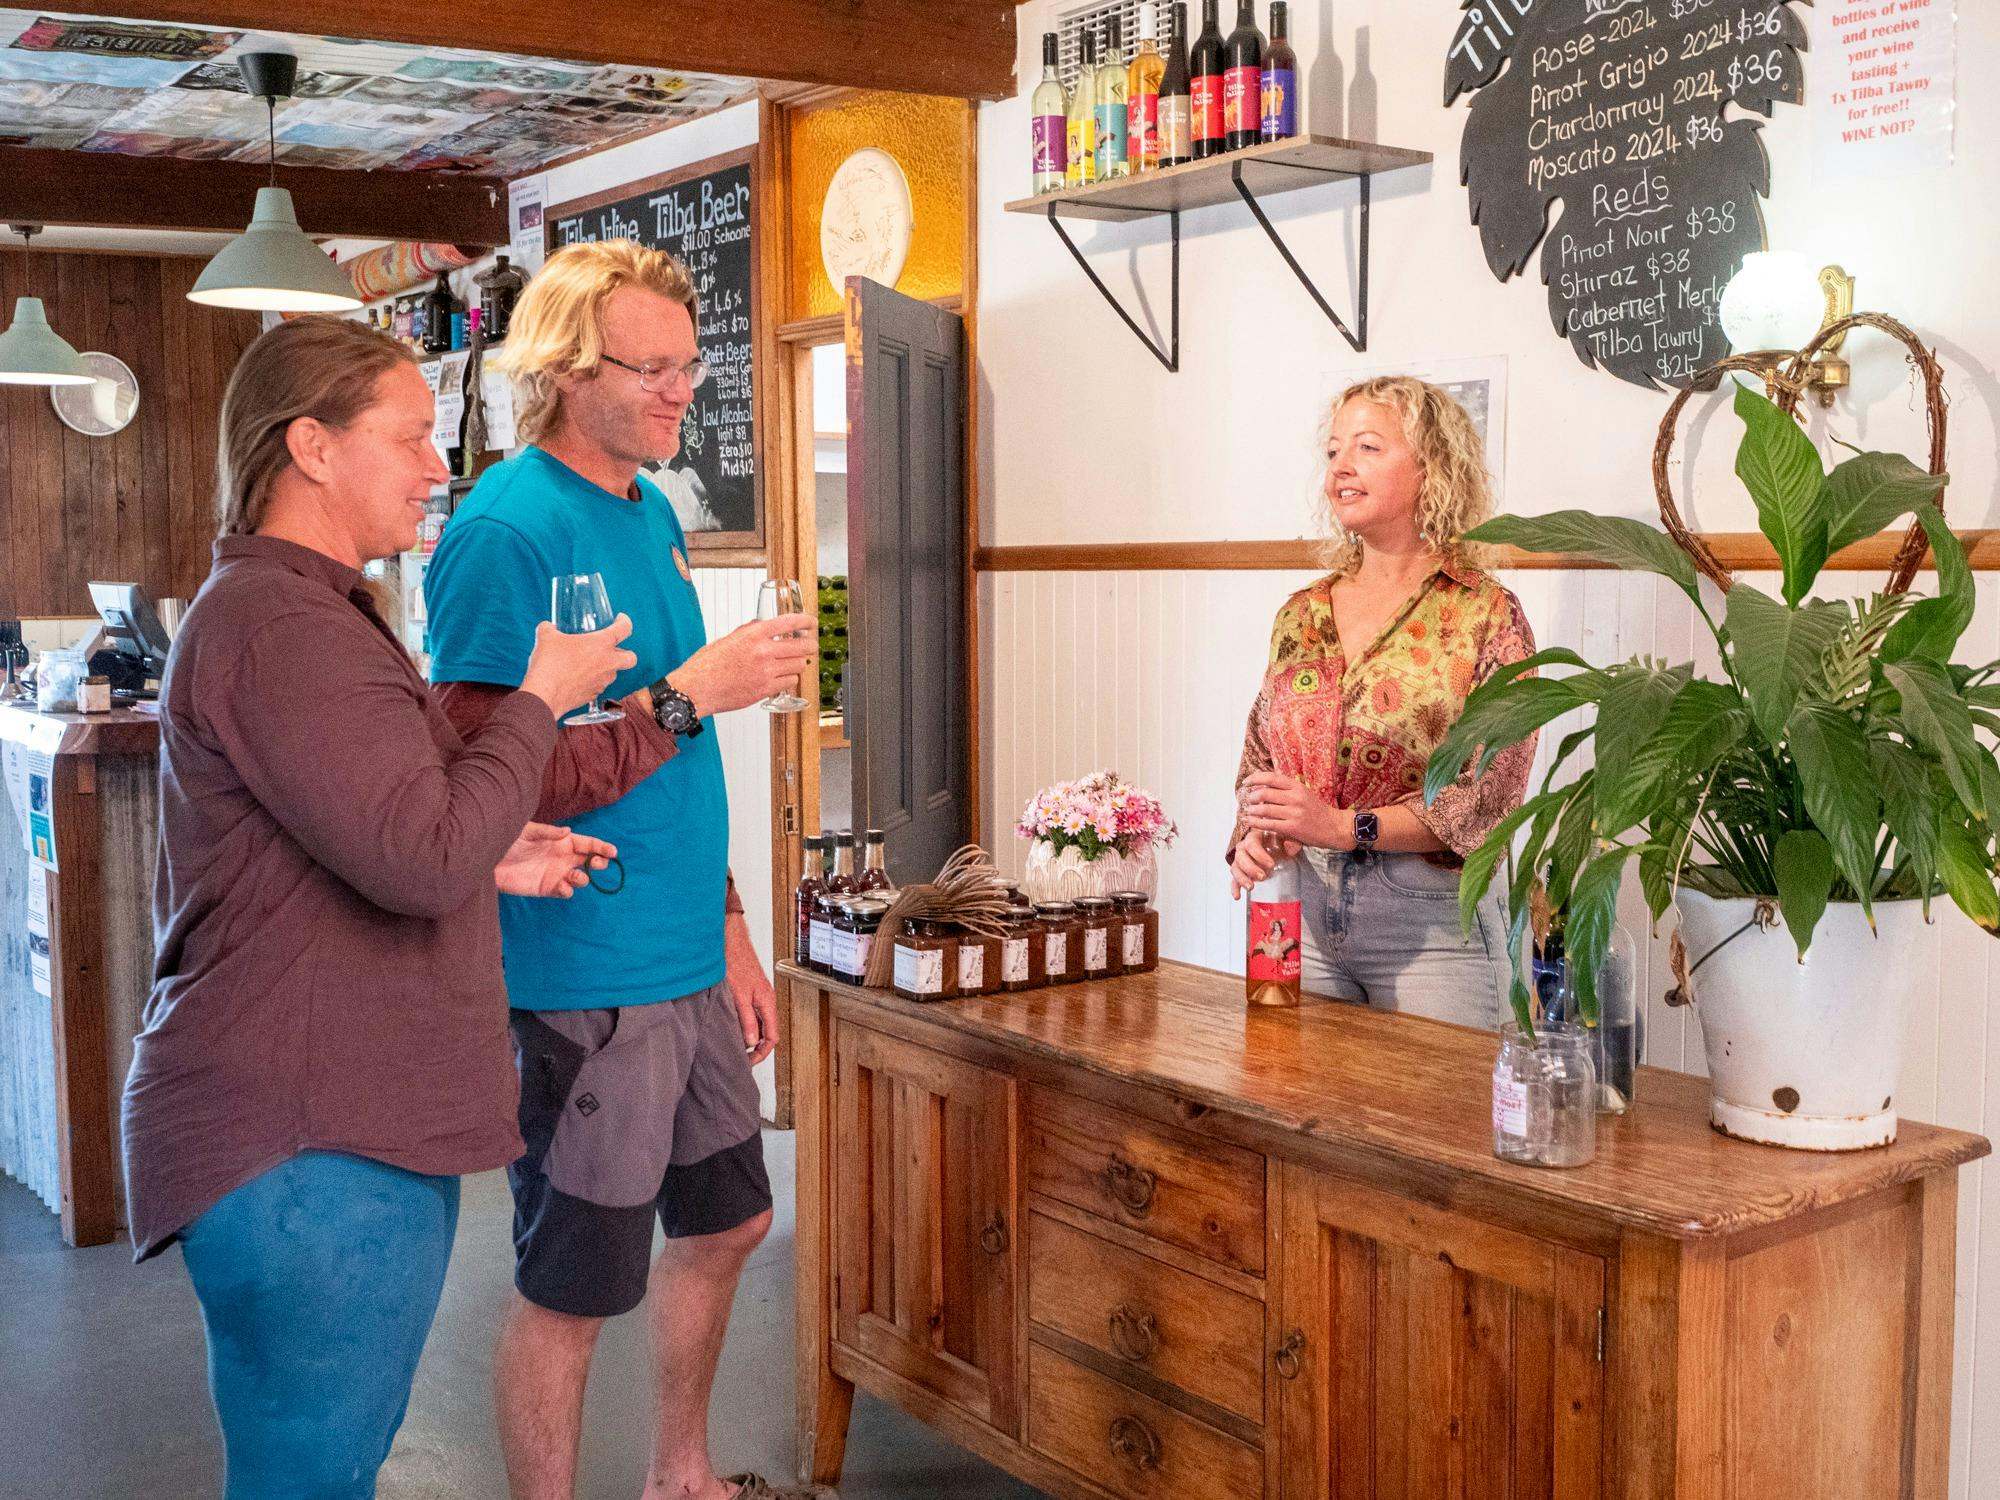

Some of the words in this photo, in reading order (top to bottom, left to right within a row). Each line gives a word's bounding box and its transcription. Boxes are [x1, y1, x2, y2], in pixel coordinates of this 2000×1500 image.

[1832, 9, 1877, 26] bottles
[1881, 3, 1895, 16] of
[1900, 0, 1930, 12] wine
[1842, 28, 1867, 44] and
[1872, 19, 1920, 38] receive
[1531, 69, 1588, 118] Pinot
[1600, 45, 1669, 89] Grigio
[1680, 19, 1733, 60] 2024
[1736, 5, 1782, 44] $36
[1848, 47, 1878, 65] your
[1882, 41, 1914, 55] wine
[1851, 62, 1898, 81] tasting
[1528, 93, 1664, 151] Chardonnay
[1673, 70, 1723, 104] 2024
[1728, 49, 1783, 96] $36
[1832, 93, 1846, 104] 1x
[1851, 86, 1883, 101] Tilba
[1888, 78, 1931, 93] Tawny
[1848, 108, 1868, 120] for
[1872, 98, 1909, 116] free!!
[1842, 126, 1876, 143] WINE
[1881, 120, 1915, 136] NOT?
[1528, 139, 1617, 191] Moscato
[1626, 124, 1682, 161] 2024
[1686, 115, 1724, 150] $36
[649, 191, 697, 239] Tilba
[700, 180, 750, 230] Beer
[1593, 168, 1670, 219] Reds
[1561, 228, 1615, 268] Pinot
[1626, 224, 1674, 249] Noir
[1686, 201, 1736, 239] $38
[1560, 265, 1638, 300] Shiraz
[1647, 248, 1691, 280] $38
[1568, 278, 1667, 332] Cabernet
[731, 313, 749, 334] $70
[1588, 327, 1643, 359] Tilba
[1643, 319, 1703, 361] Tawny
[736, 424, 747, 440] $8
